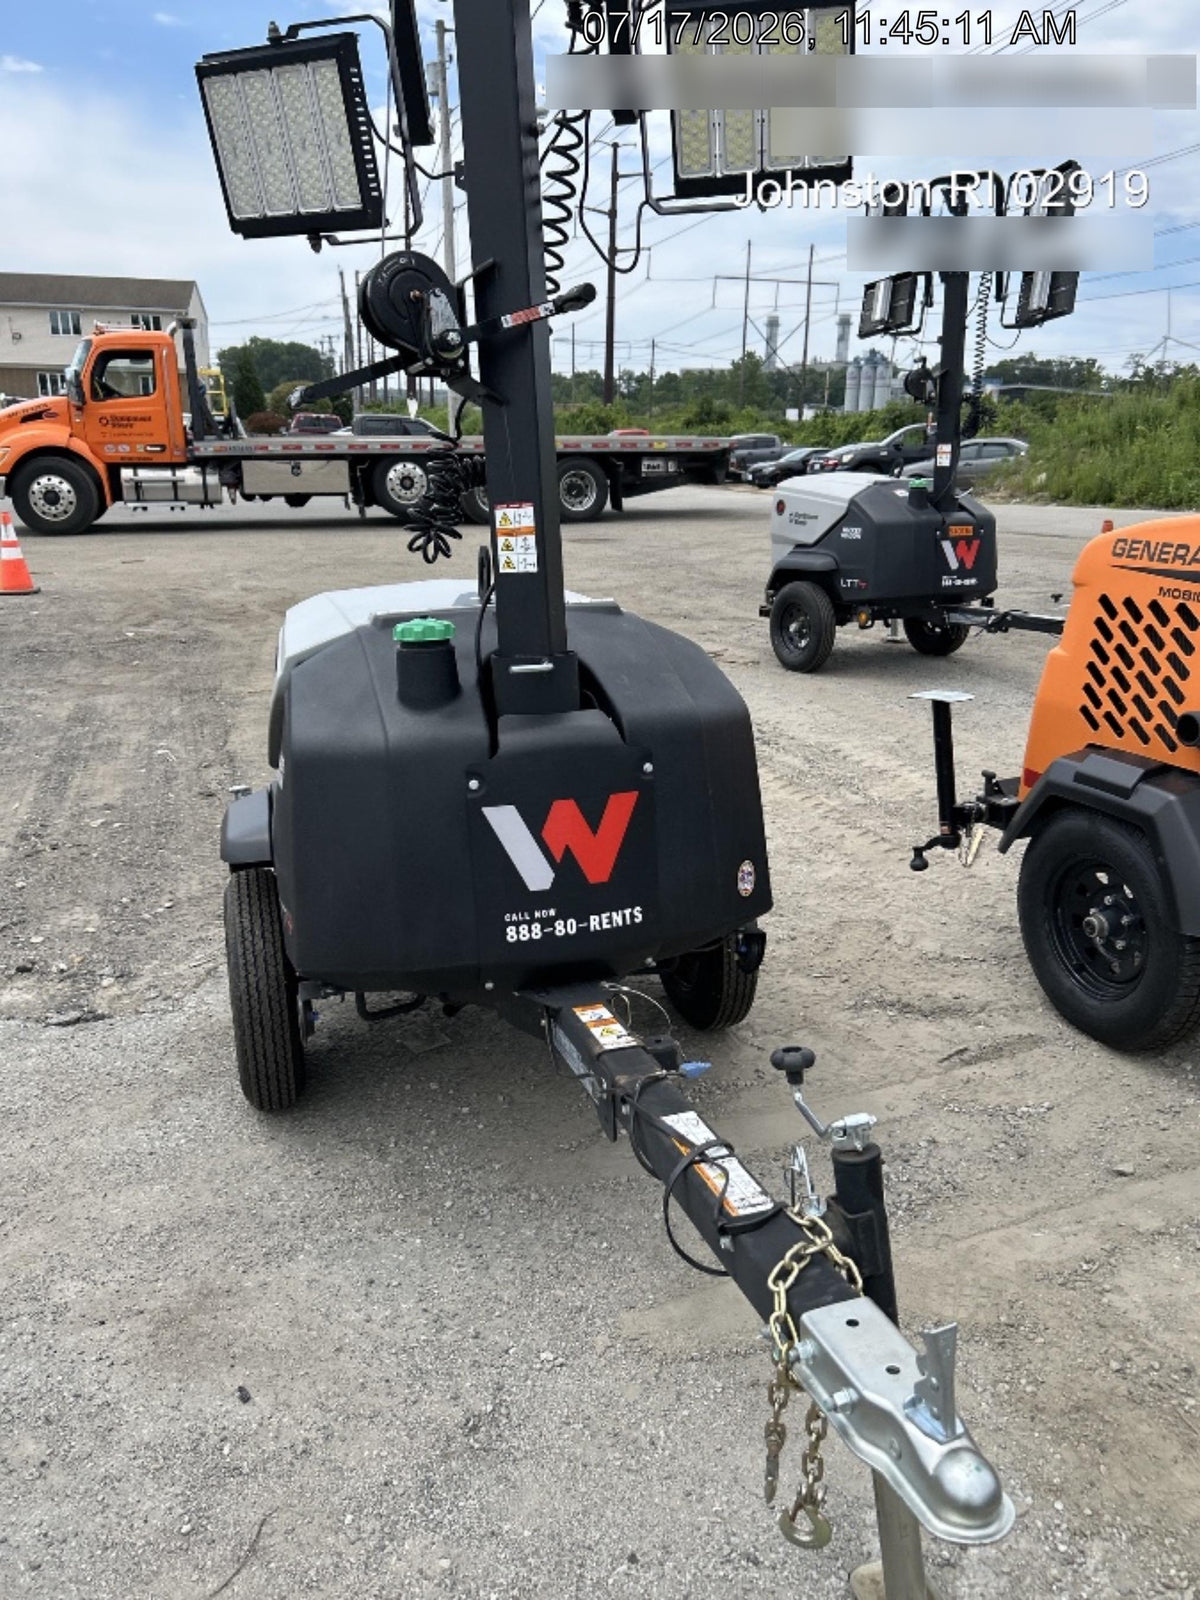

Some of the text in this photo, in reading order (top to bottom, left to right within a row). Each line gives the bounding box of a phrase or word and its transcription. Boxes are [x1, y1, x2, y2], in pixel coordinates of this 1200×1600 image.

[504, 908, 557, 922] CALL NOW
[505, 906, 643, 943] 888-80-RENTS
